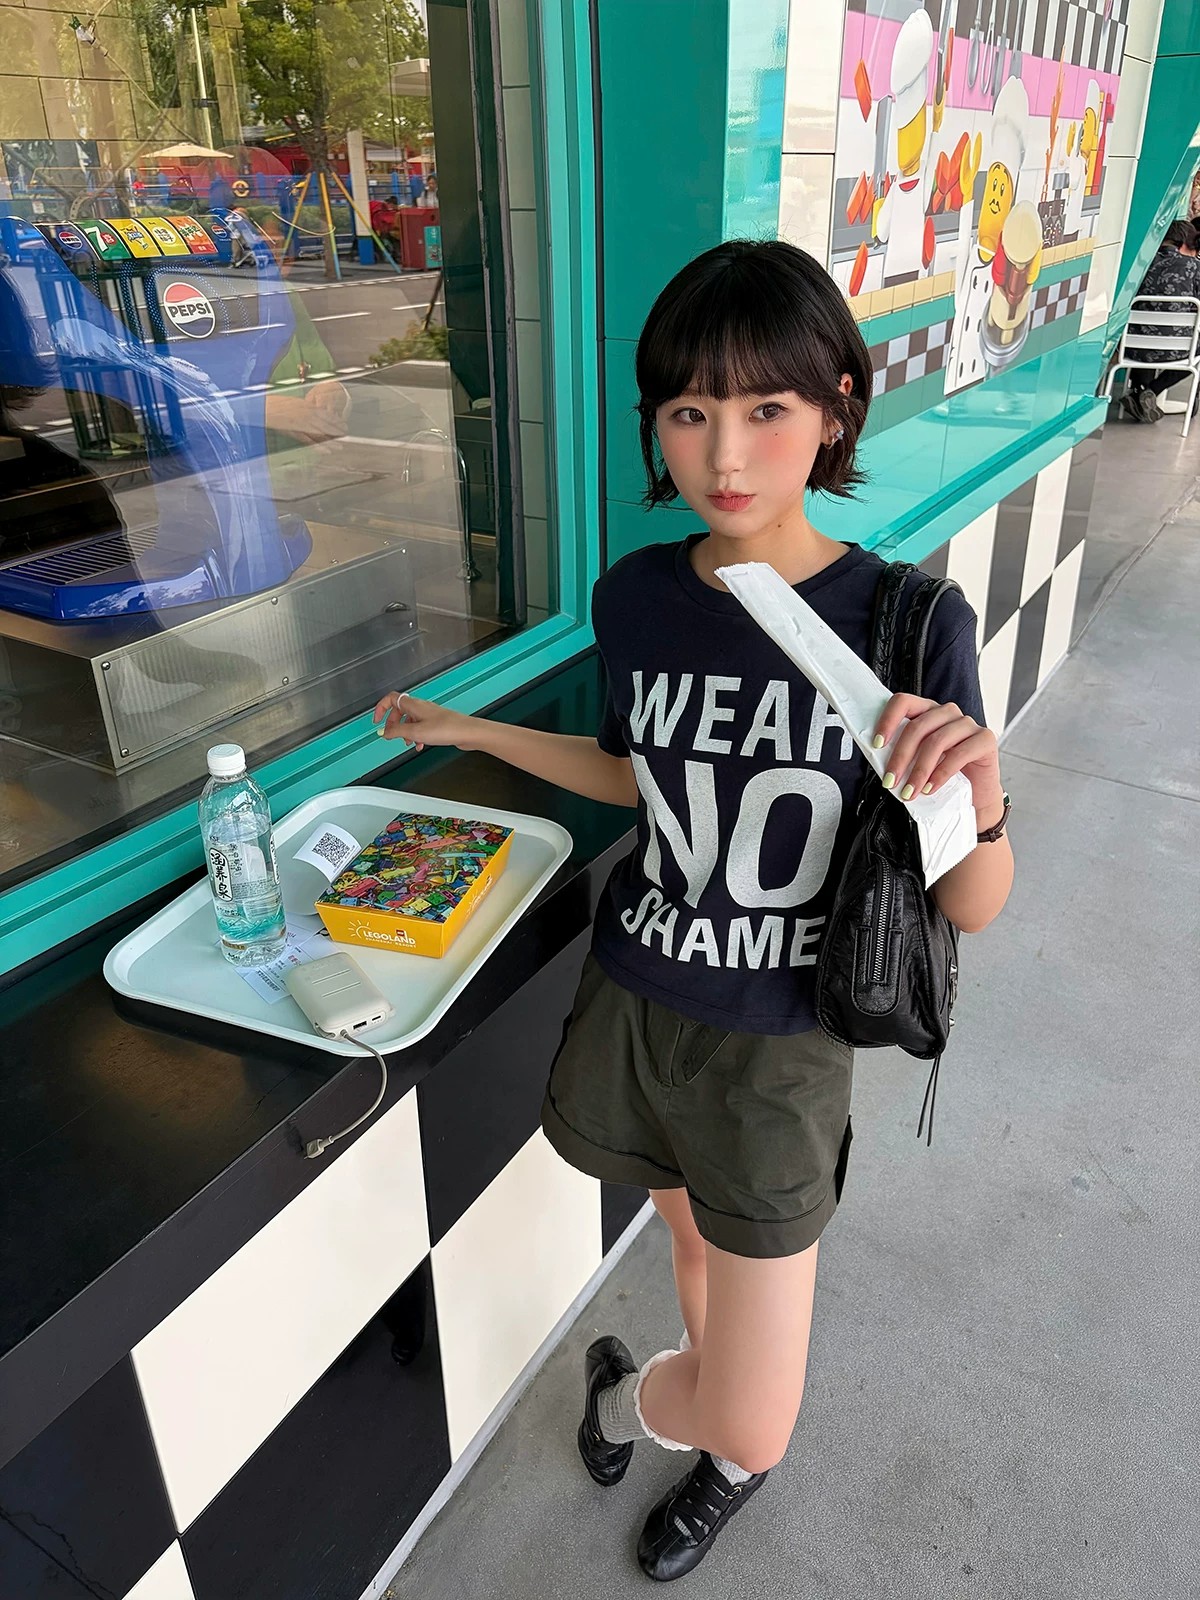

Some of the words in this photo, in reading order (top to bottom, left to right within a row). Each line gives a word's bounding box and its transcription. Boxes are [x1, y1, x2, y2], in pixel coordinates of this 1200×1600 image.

[168, 302, 212, 318] PEPSI
[630, 749, 843, 909] NO
[363, 930, 416, 945] LEGOLAND
[620, 888, 826, 970] SHAME
